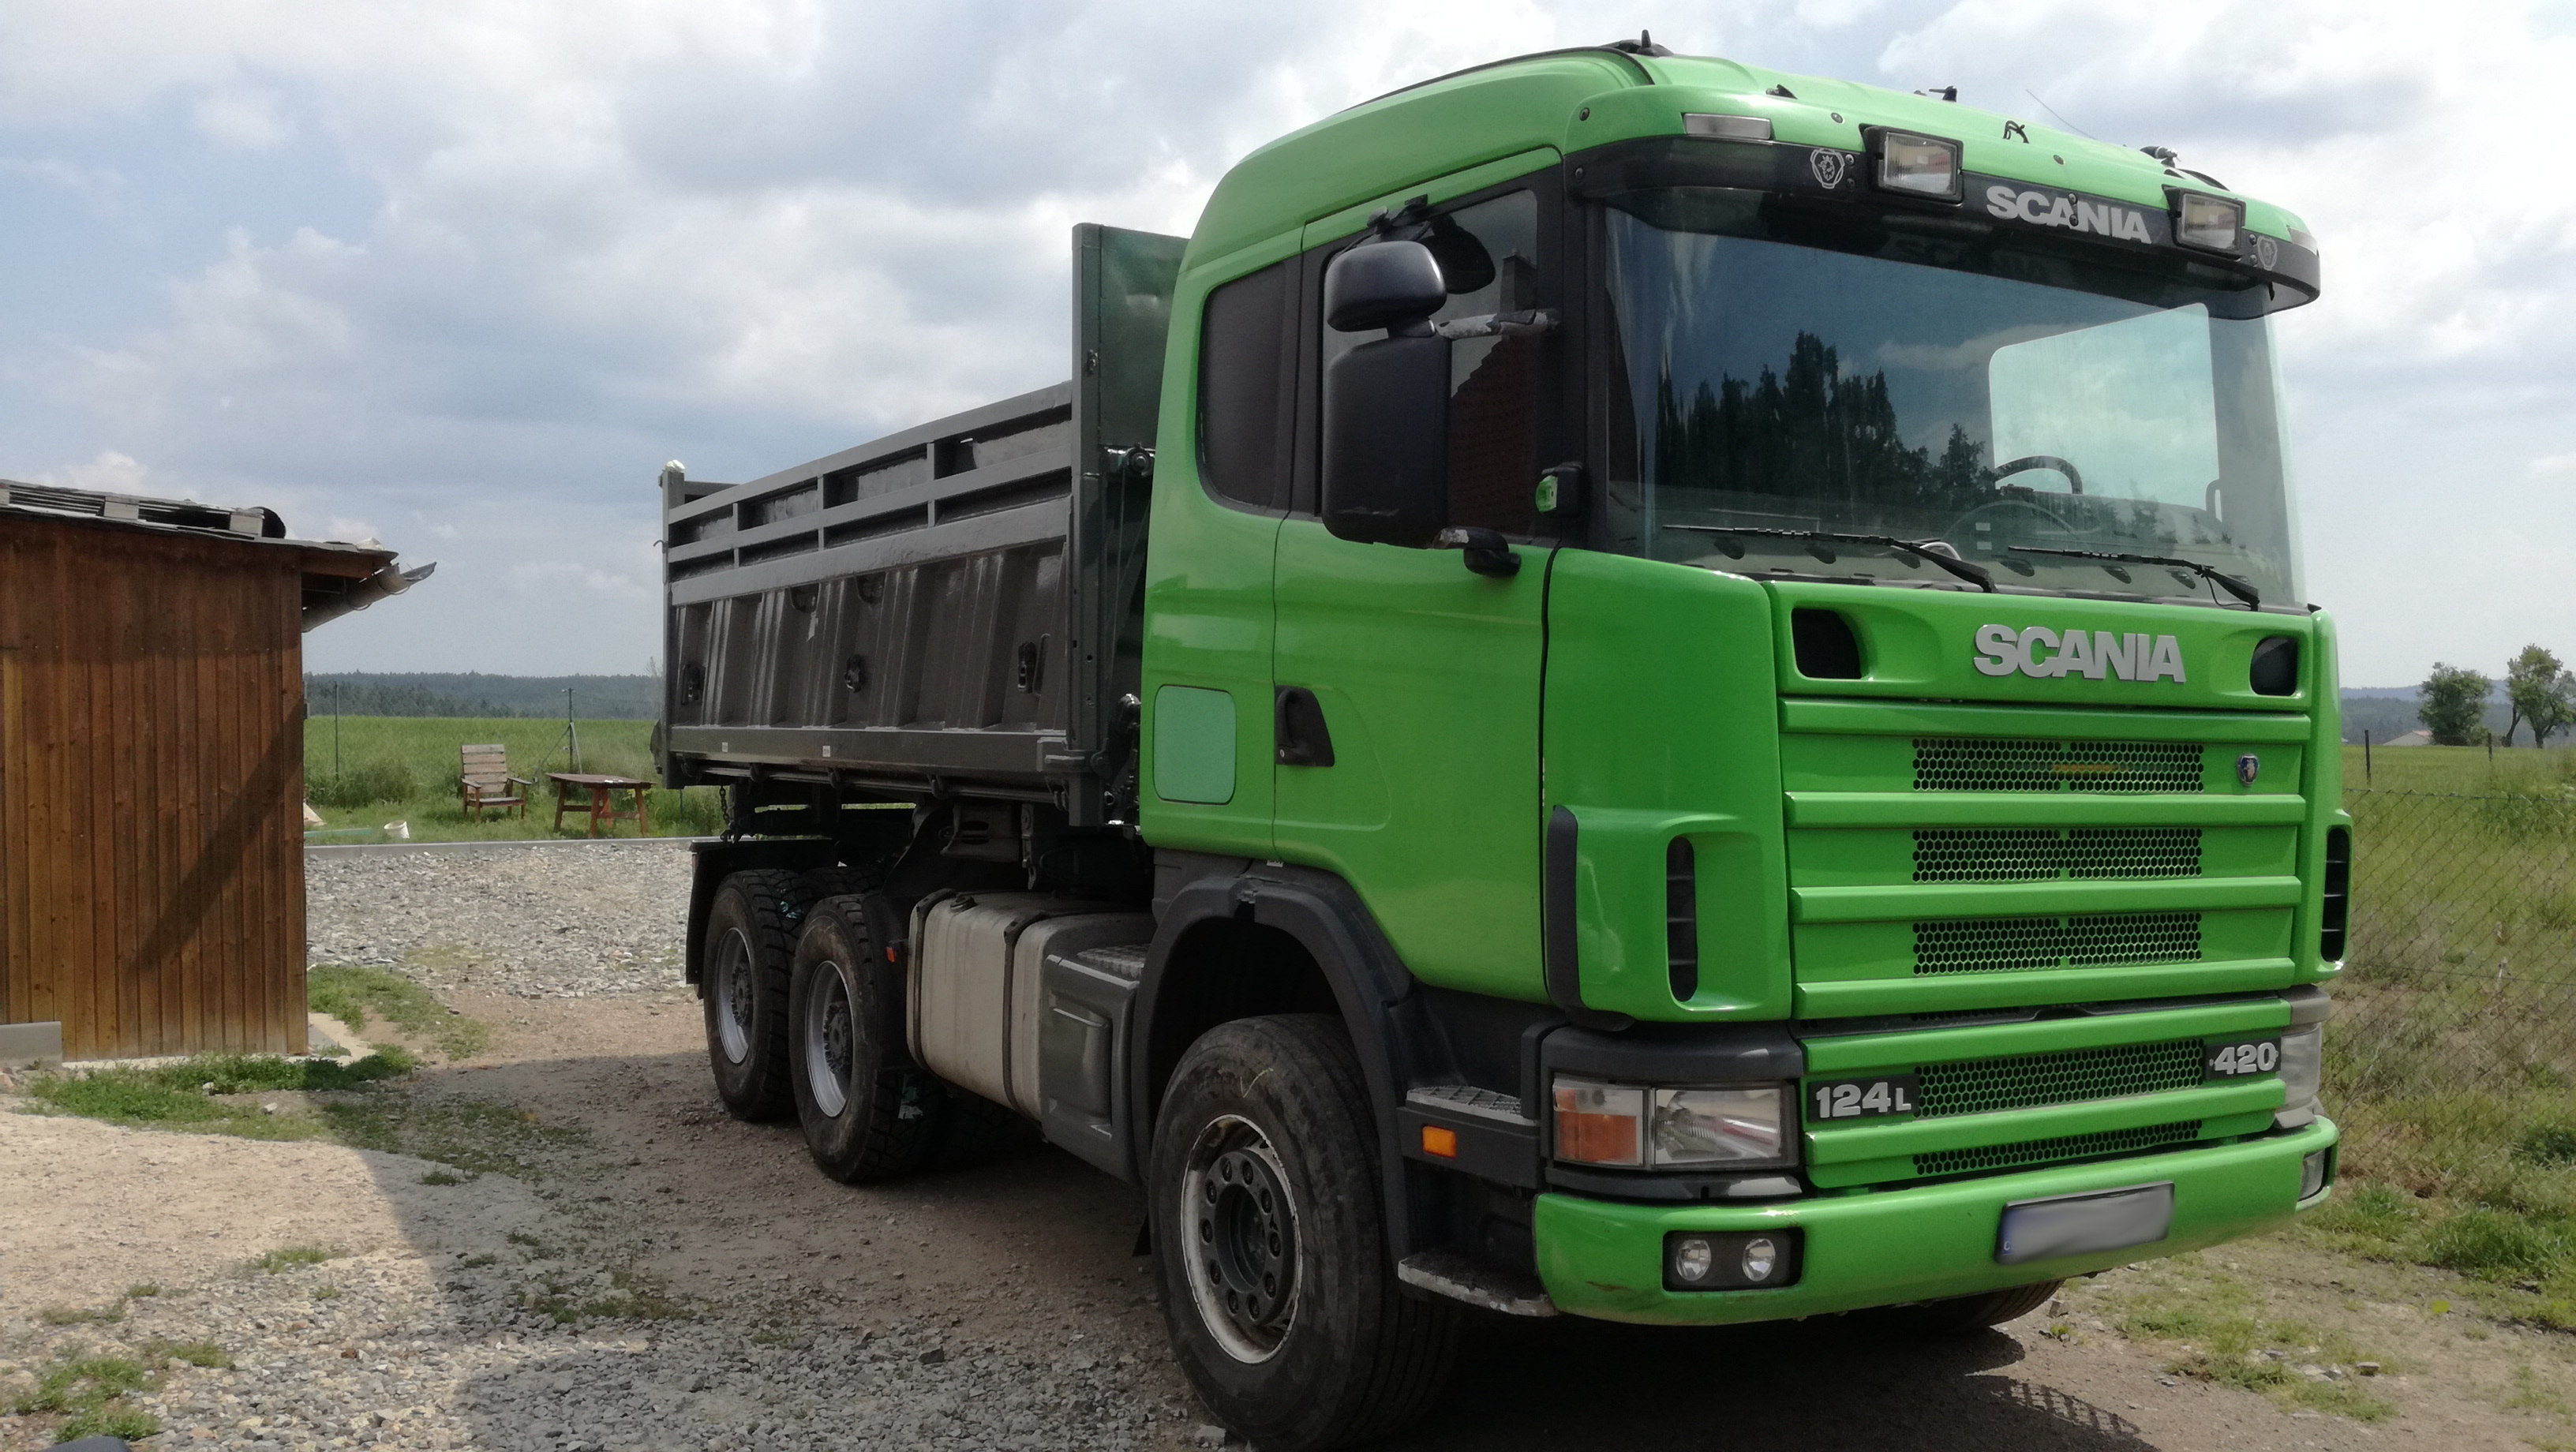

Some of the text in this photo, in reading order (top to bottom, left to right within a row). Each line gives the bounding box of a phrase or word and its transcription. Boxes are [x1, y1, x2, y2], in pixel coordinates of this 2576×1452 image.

[1986, 185, 2153, 245] SCANIA
[1973, 623, 2187, 683] SCANIA
[2214, 1042, 2277, 1075] 420
